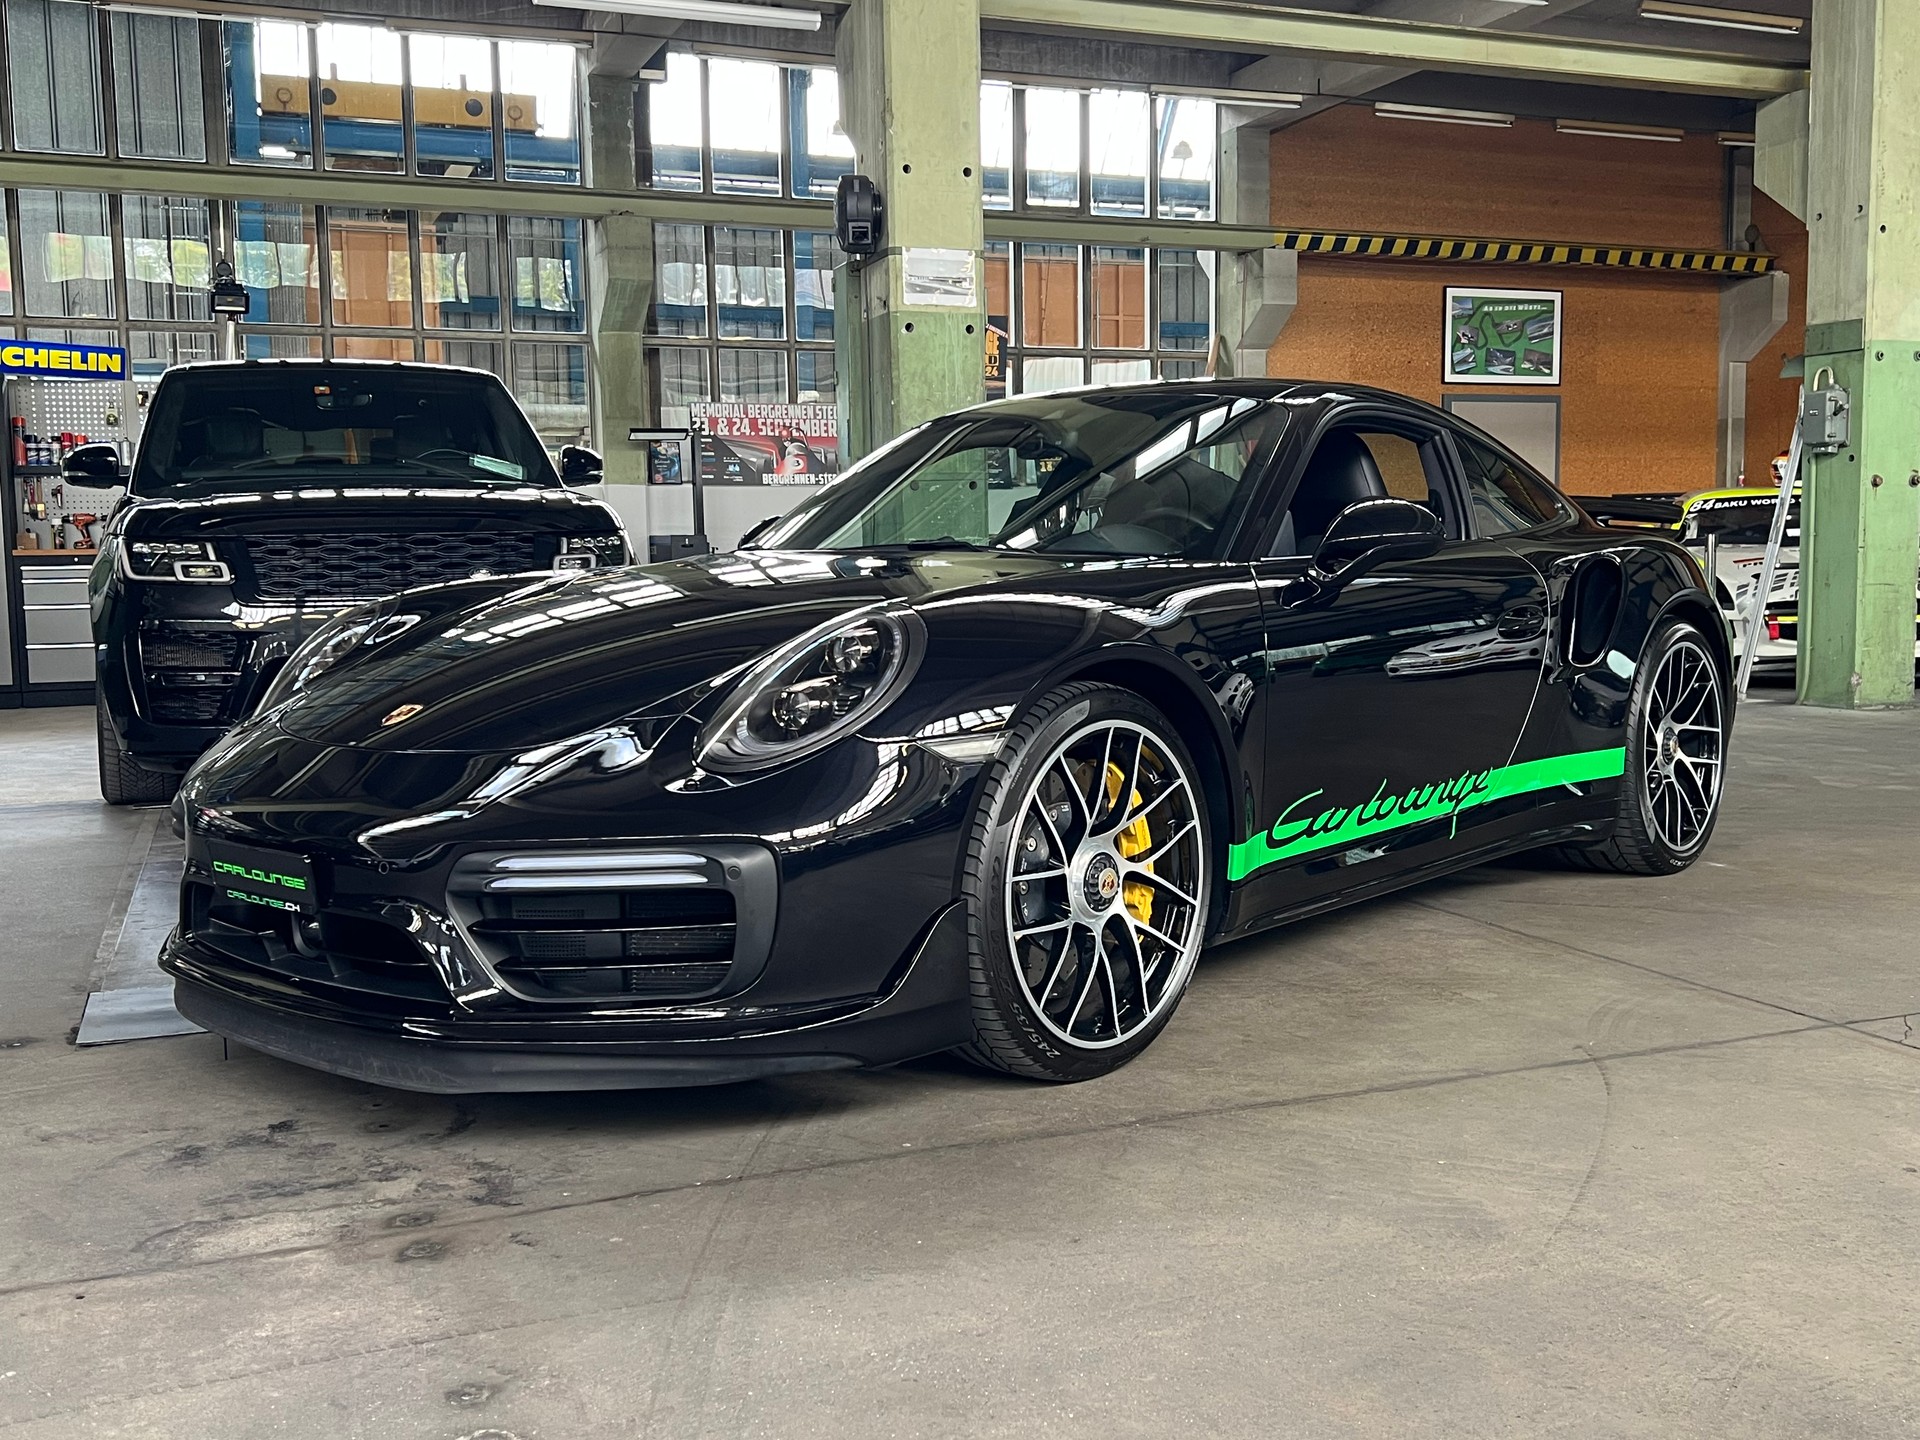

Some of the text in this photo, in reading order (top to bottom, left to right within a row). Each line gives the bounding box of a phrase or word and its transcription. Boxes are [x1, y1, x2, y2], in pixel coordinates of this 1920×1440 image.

[0, 346, 121, 373] CHELIN
[691, 402, 746, 418] MEMORIAL
[747, 404, 814, 419] BERGRENNEN
[717, 417, 730, 436] &
[732, 417, 756, 436] 24.
[1714, 499, 1748, 510] BAKU
[213, 861, 306, 890] CARLOUNGE
[226, 889, 301, 913] CARLOUNGE.CH
[1009, 1002, 1061, 1059] 245/35
